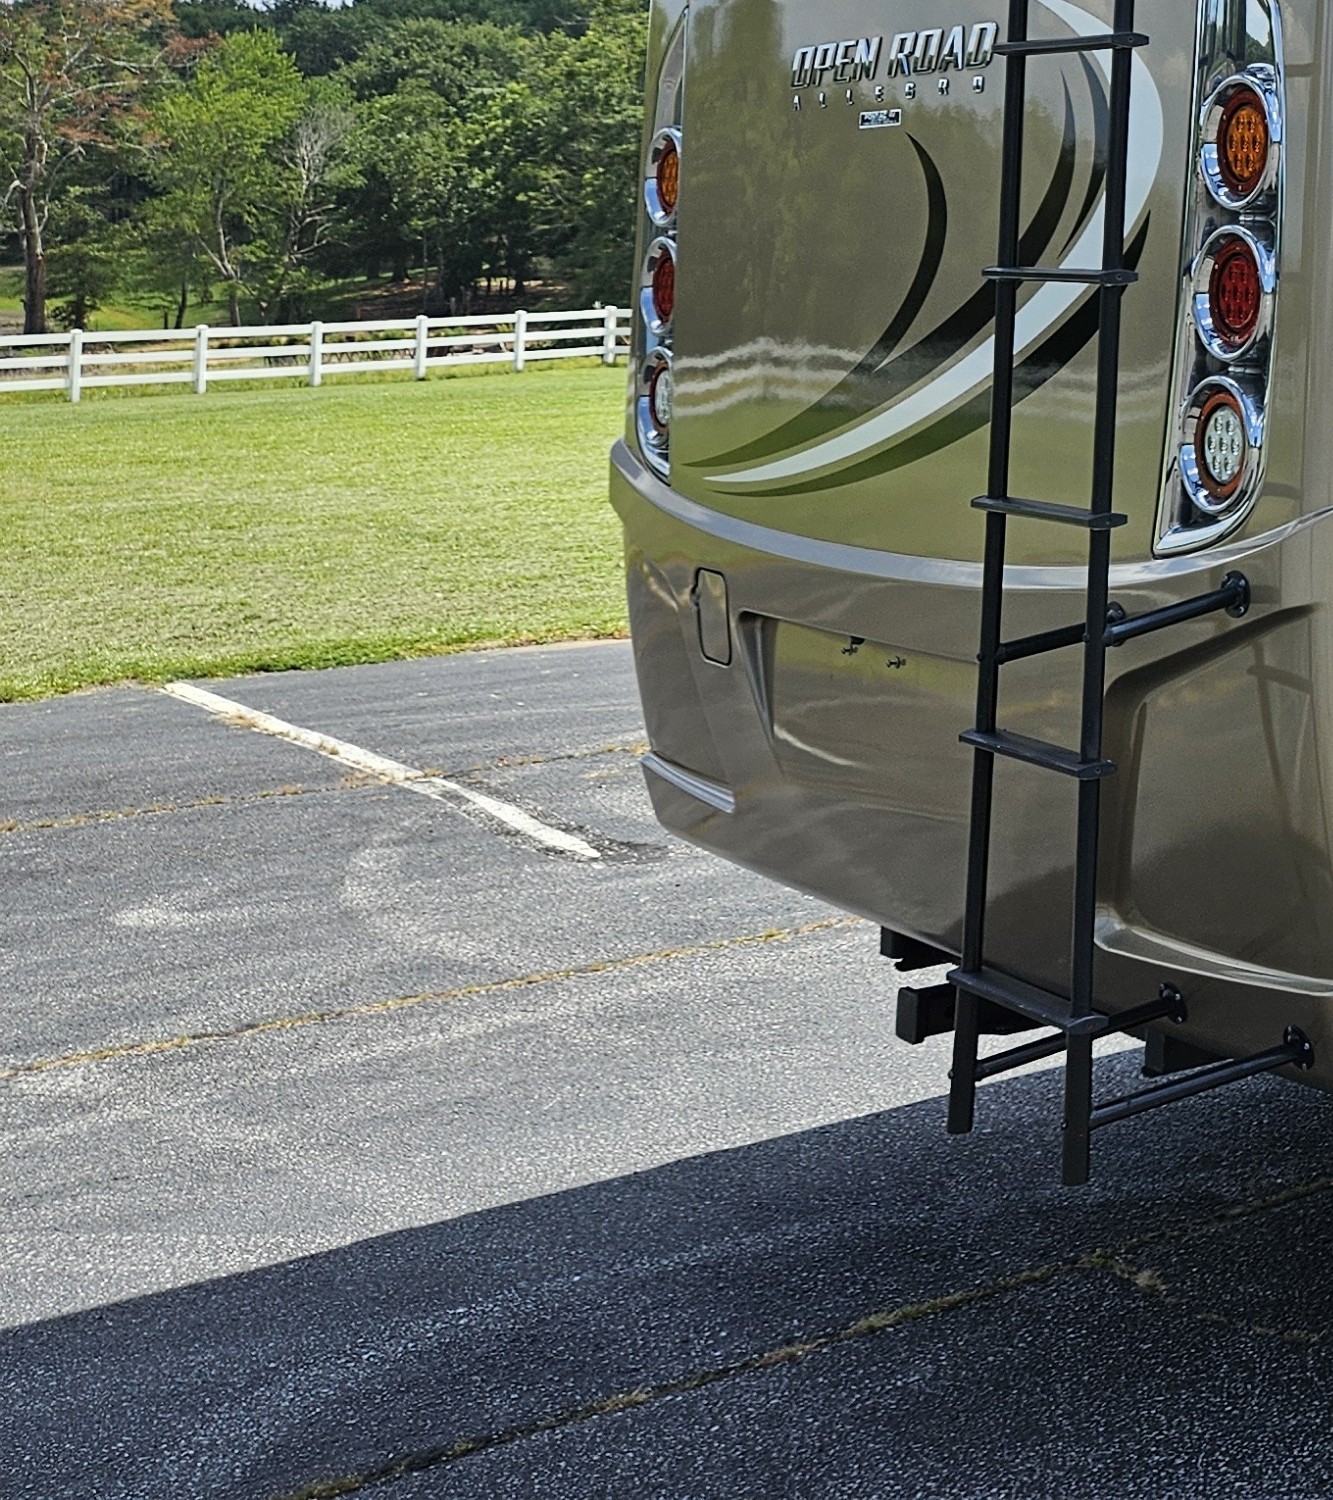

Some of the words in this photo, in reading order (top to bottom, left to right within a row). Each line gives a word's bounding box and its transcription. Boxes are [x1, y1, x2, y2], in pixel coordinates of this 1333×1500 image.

[791, 35, 882, 89] OPEN
[887, 21, 998, 78] ROAD
[792, 75, 984, 111] ALLEGRO
